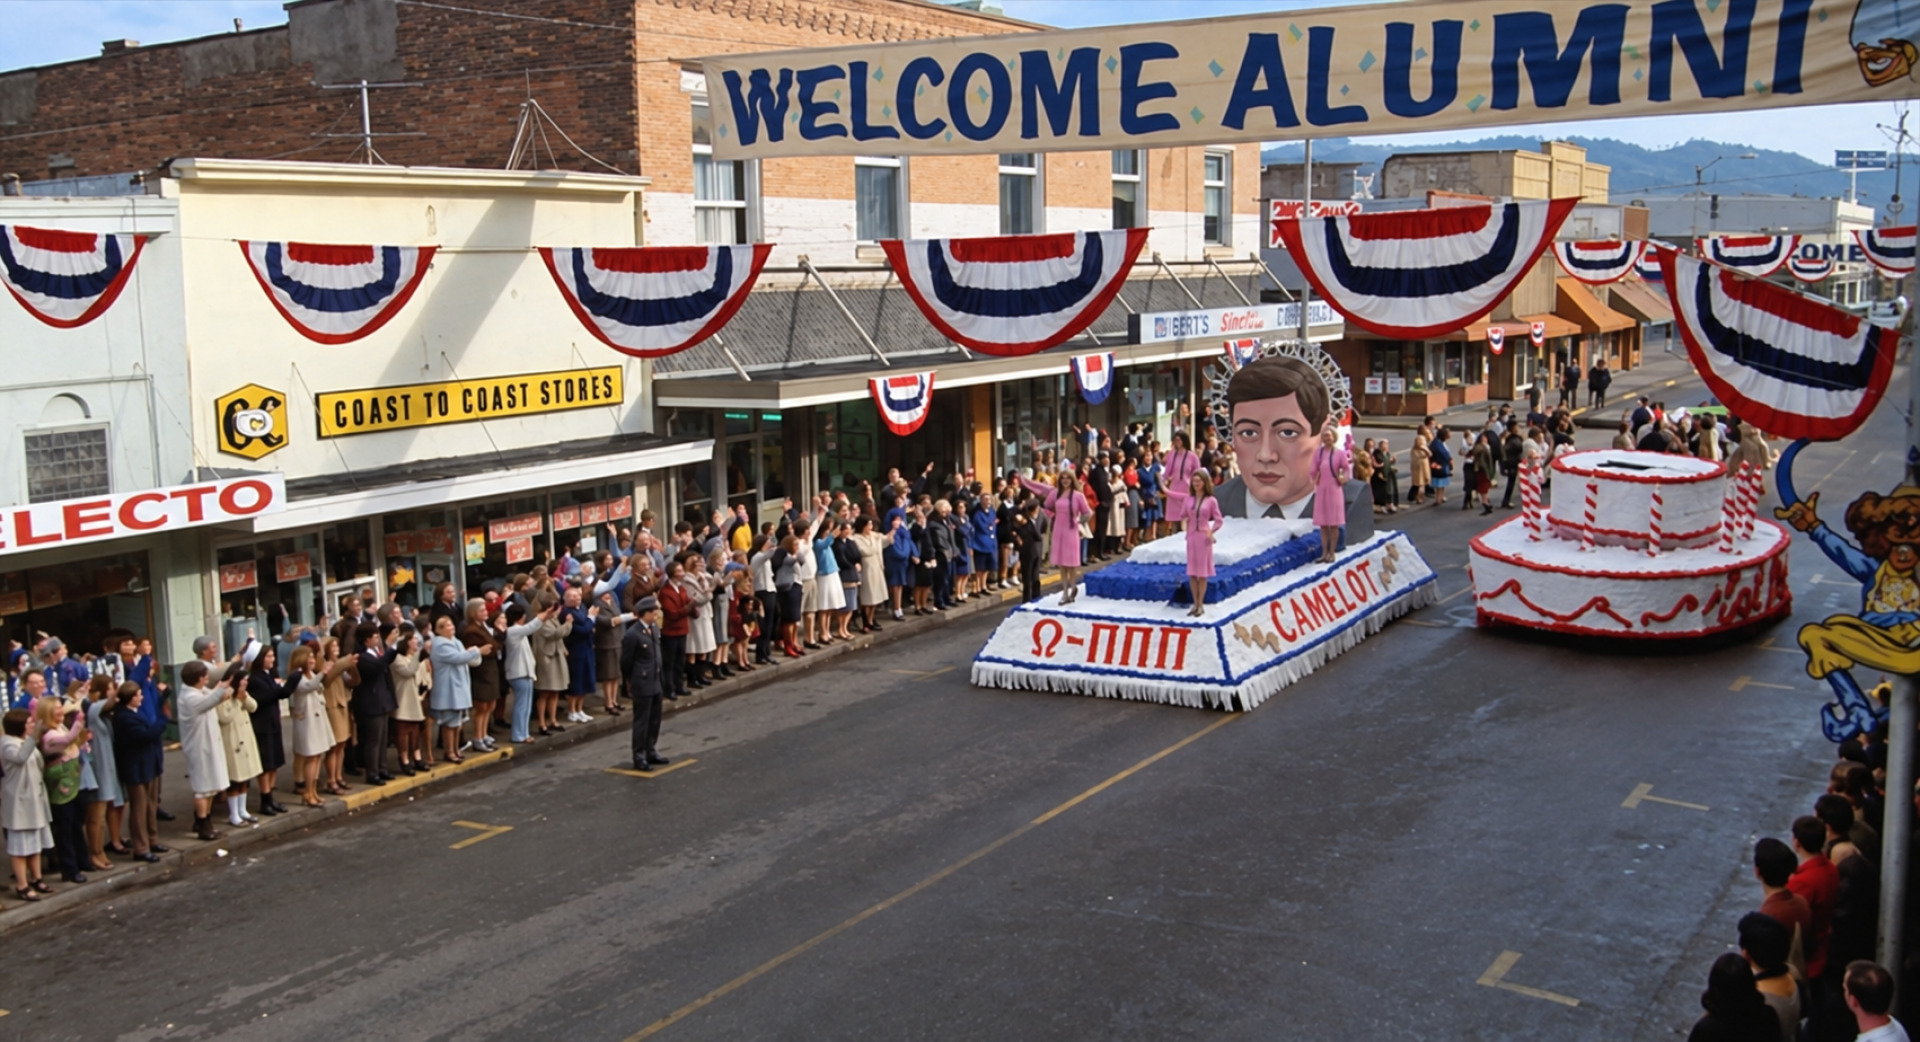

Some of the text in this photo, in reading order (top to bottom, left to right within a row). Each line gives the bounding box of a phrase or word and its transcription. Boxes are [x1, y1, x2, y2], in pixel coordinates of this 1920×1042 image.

[721, 0, 1811, 146] WELCOME ALUMNI
[335, 374, 612, 428] COAST TO COAST STORES
[0, 480, 273, 548] LECTO
[1270, 560, 1379, 643] CAMELOT
